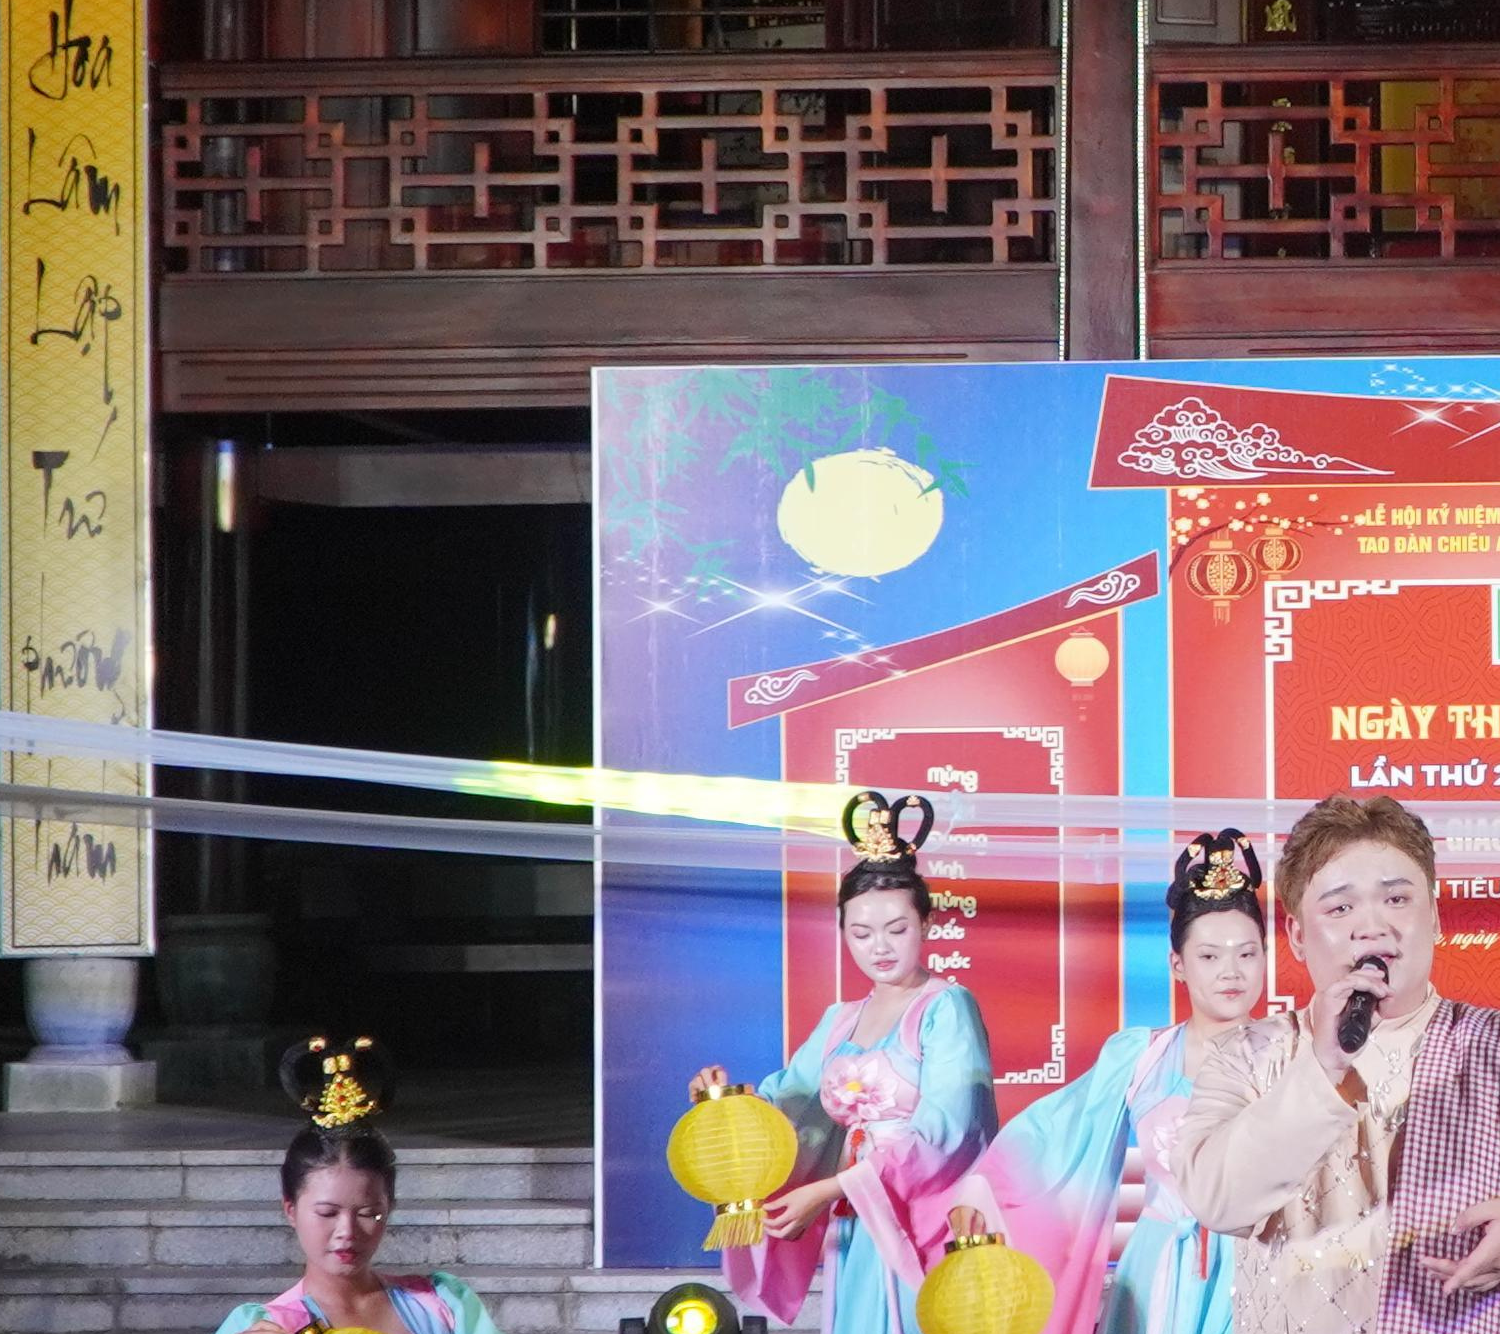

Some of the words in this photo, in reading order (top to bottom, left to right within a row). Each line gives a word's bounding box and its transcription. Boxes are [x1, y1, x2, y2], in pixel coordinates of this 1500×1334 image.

[1391, 504, 1422, 529] HỘI
[1357, 535, 1390, 554] TAO
[1394, 533, 1432, 553] ĐÀN
[1437, 532, 1491, 553] CHIÊU
[1330, 699, 1435, 741] NGÀY
[1350, 755, 1414, 789] LẦN
[1420, 757, 1488, 788] THỨ
[1450, 929, 1499, 950] ngày
